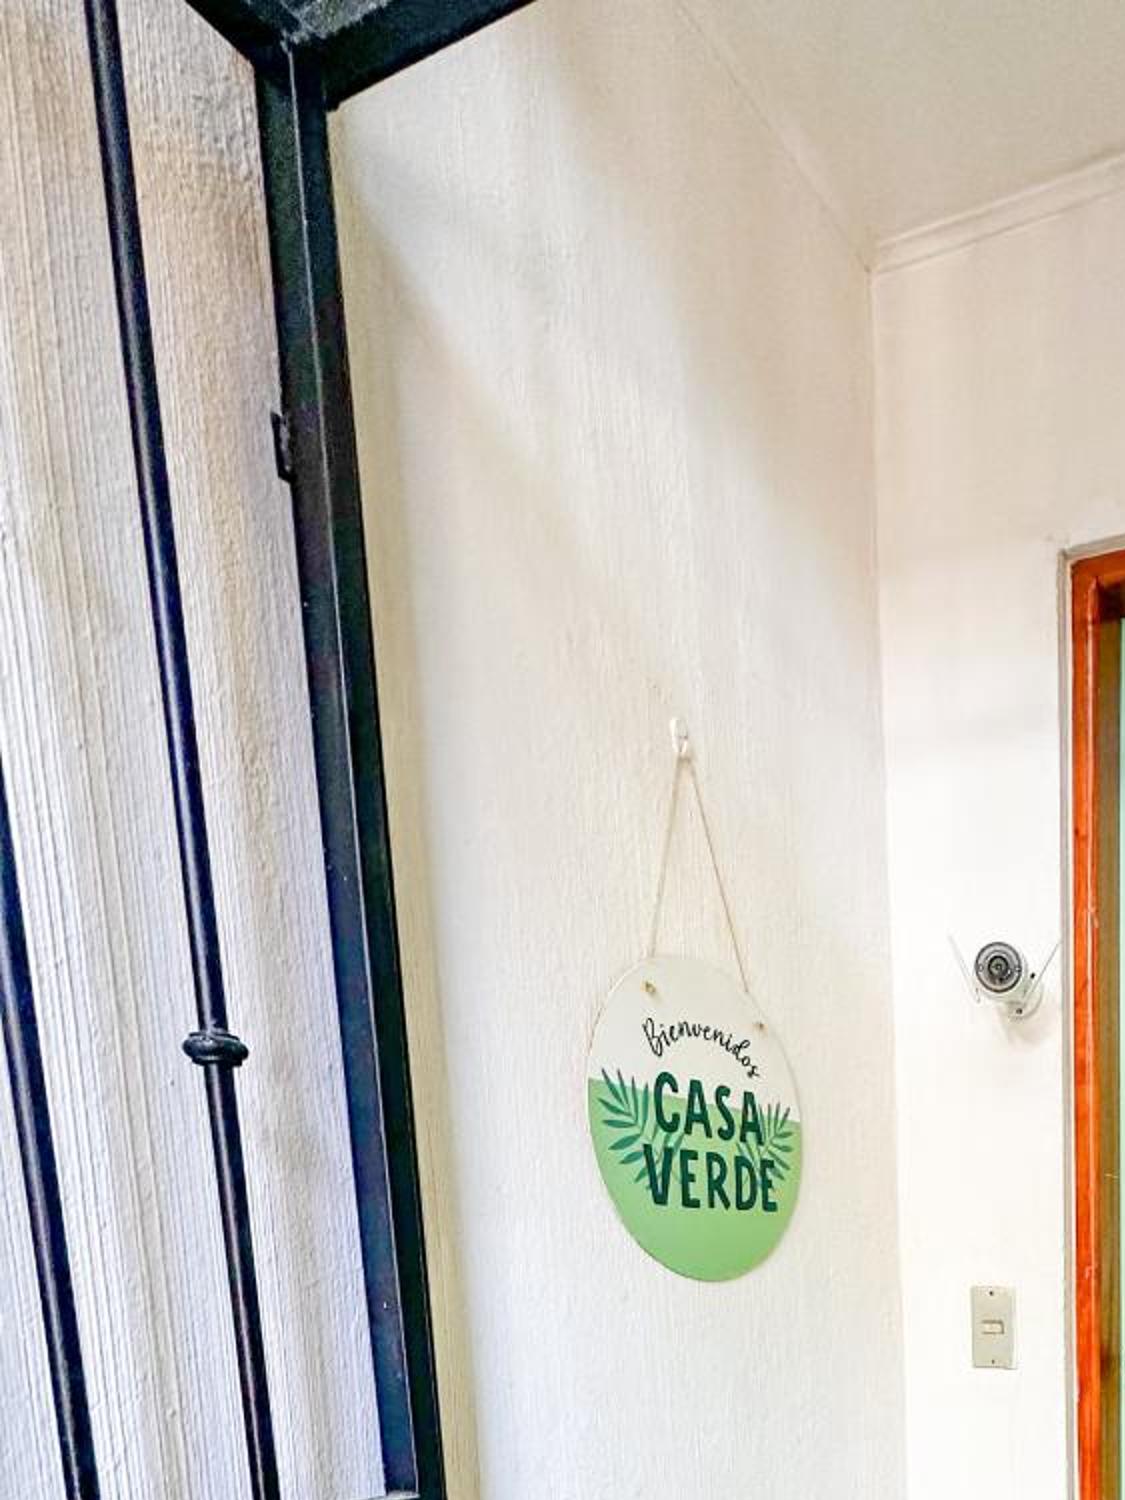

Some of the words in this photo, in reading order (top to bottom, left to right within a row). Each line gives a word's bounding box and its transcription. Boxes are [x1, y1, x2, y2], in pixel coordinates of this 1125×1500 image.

[642, 1017, 760, 1078] Bienvenidos
[653, 1071, 764, 1146] CASA
[643, 1143, 778, 1212] VERDE
